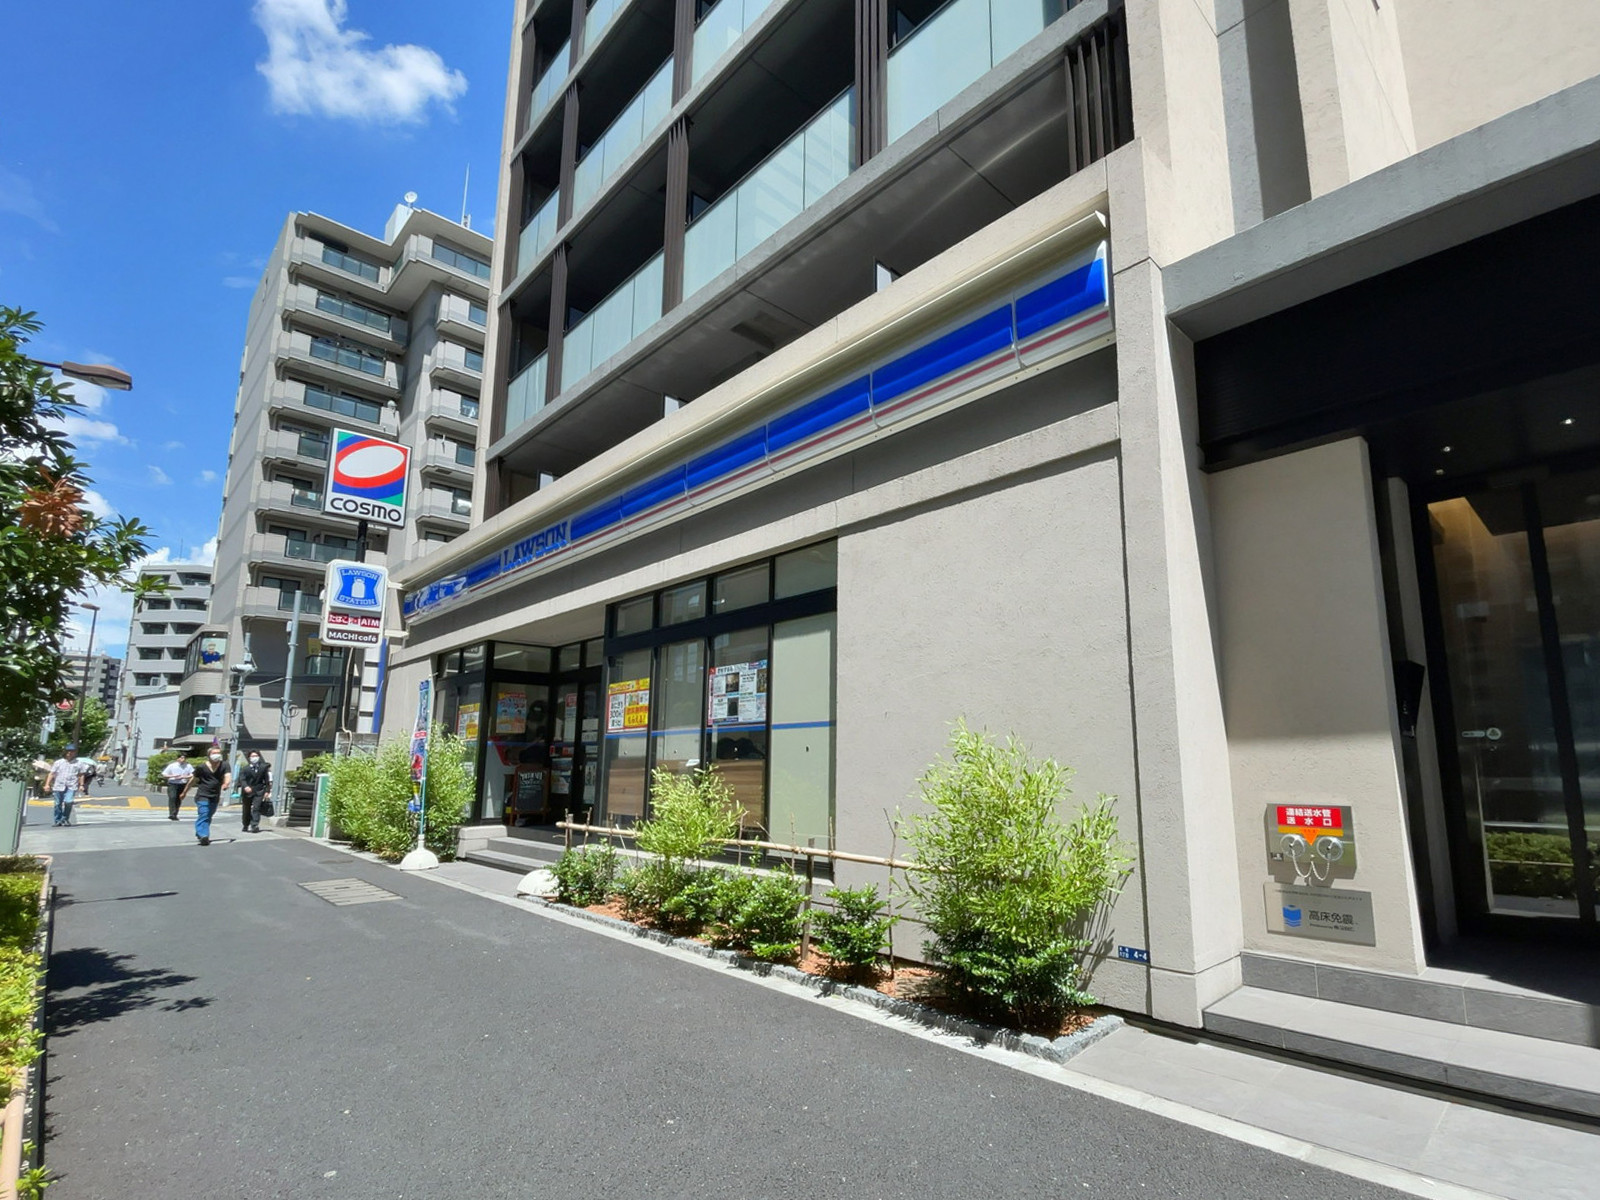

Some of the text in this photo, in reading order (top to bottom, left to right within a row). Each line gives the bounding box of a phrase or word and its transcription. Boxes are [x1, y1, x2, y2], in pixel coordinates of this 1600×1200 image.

[330, 497, 402, 522] COSMO
[503, 522, 569, 567] LAWSON
[341, 569, 379, 581] LAWSON
[338, 594, 376, 606] STATION
